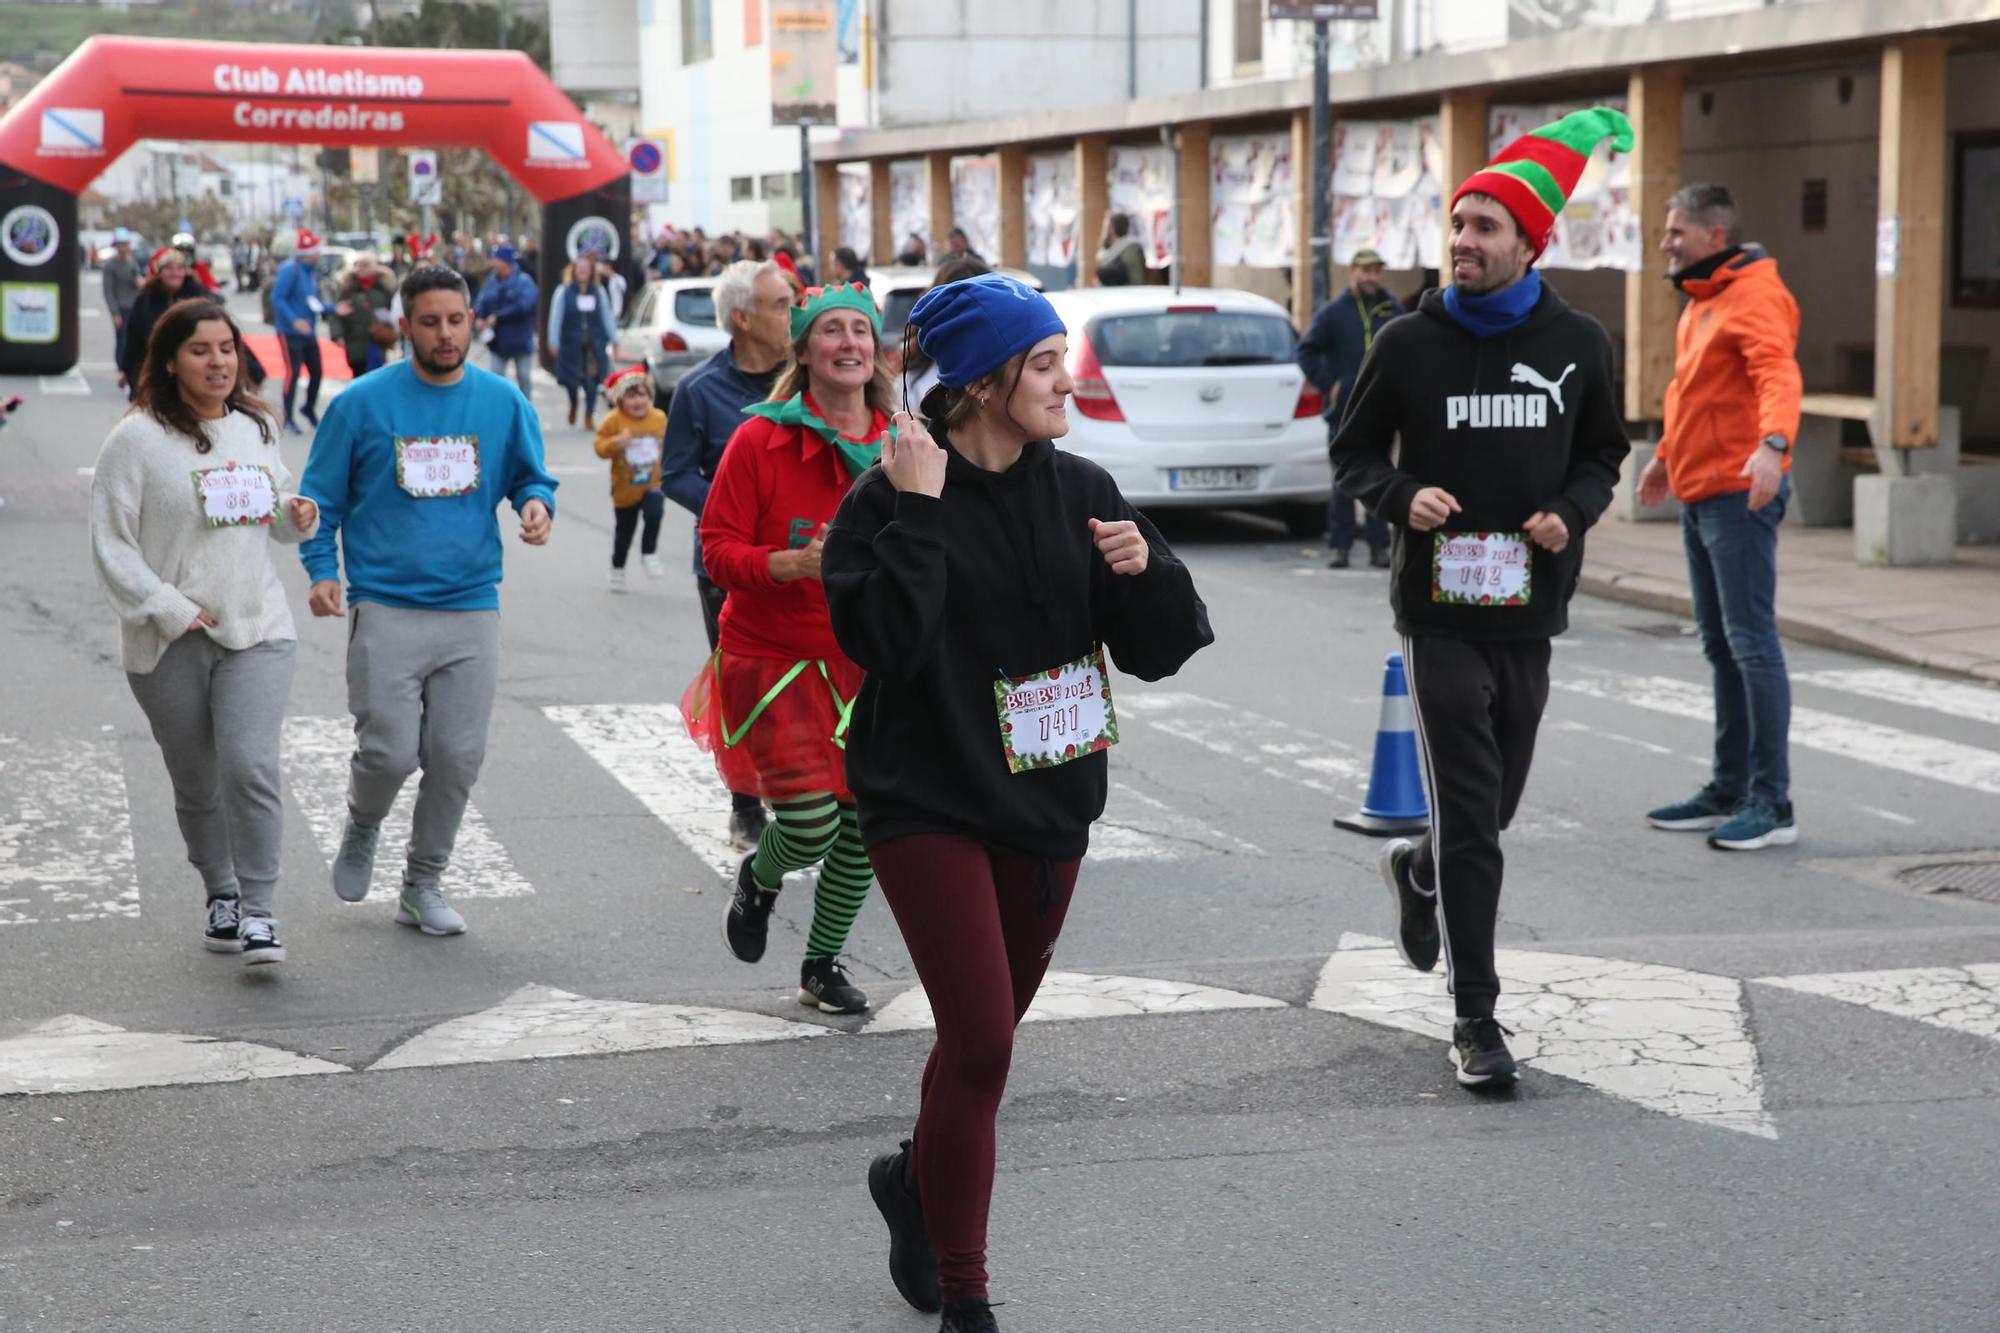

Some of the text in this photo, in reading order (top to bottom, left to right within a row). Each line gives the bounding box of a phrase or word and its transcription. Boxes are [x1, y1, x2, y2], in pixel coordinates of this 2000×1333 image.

[213, 64, 424, 97] Club Atletismo
[233, 102, 404, 131] Corredoiras
[1446, 394, 1548, 429] PUMA
[1460, 566, 1501, 586] 142
[1039, 704, 1078, 741] 141
